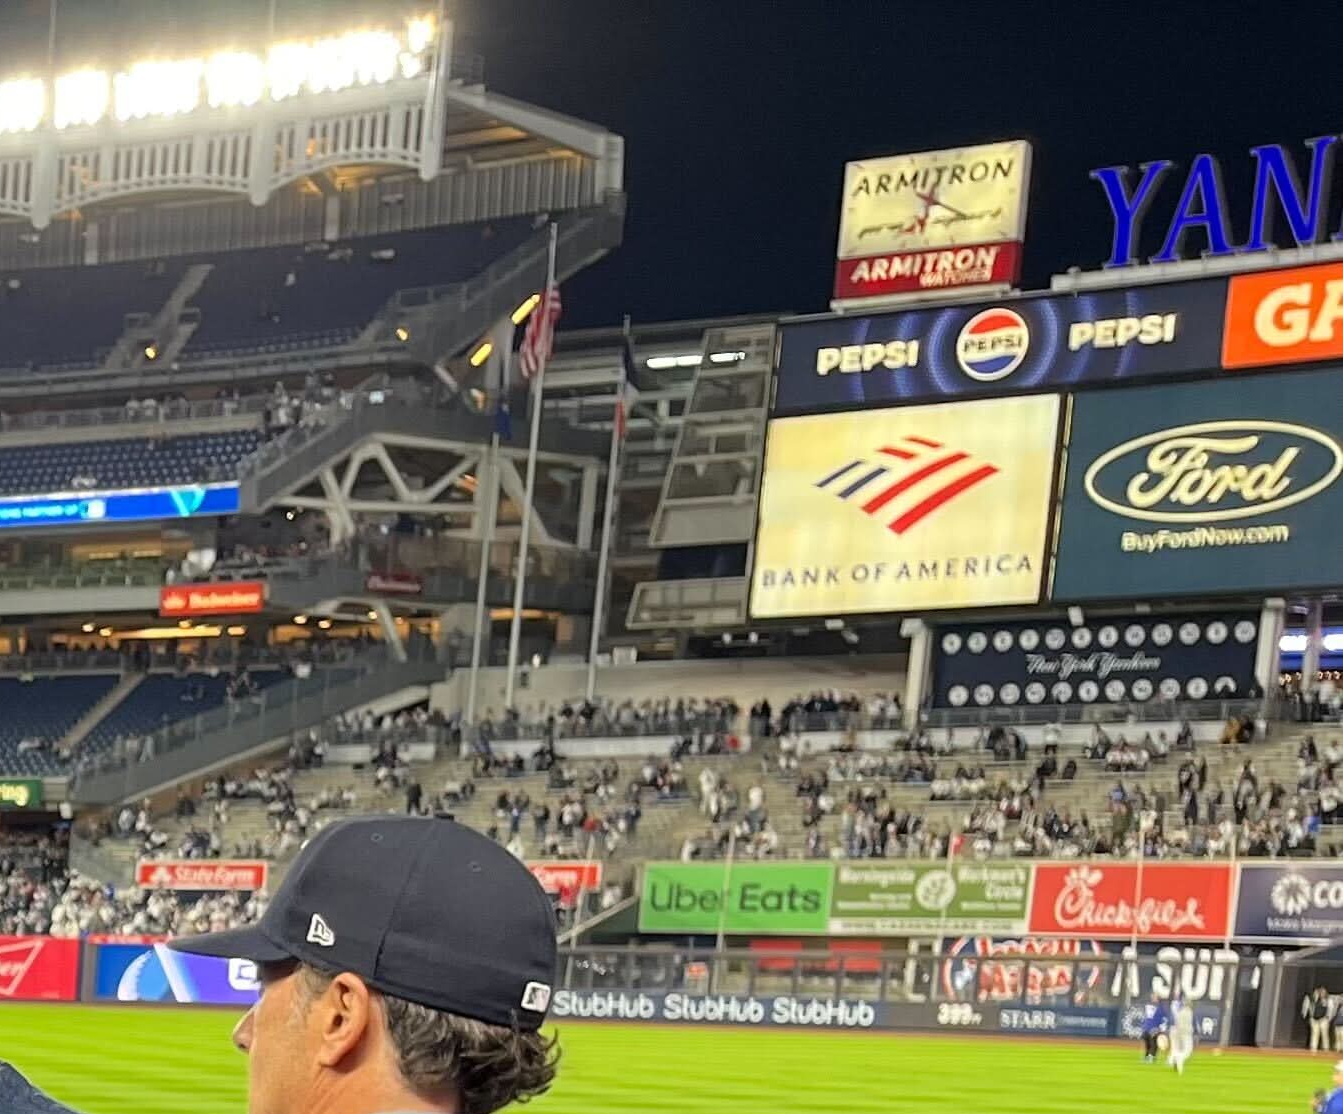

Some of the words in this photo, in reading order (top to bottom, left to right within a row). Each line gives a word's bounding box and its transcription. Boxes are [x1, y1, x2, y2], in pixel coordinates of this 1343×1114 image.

[852, 160, 1013, 197] ARMITRON
[1090, 136, 1343, 268] YAN
[851, 247, 1000, 283] ARMITRON
[964, 335, 1024, 354] PEPSI
[1068, 313, 1178, 351] PEPSI
[817, 341, 919, 376] PEPSI
[1126, 434, 1301, 508] Ford
[1121, 523, 1290, 553] BuyFordNow.com
[761, 566, 840, 589] BANK
[852, 560, 885, 583] OF
[897, 553, 1034, 580] AMERICA
[1059, 653, 1098, 680] York
[1096, 651, 1162, 679] Yankees
[740, 883, 821, 913] Eats
[552, 990, 654, 1018] StubHub
[663, 993, 763, 1023] StubHub
[772, 997, 874, 1027] StubHub
[1000, 1008, 1057, 1029] STARR
